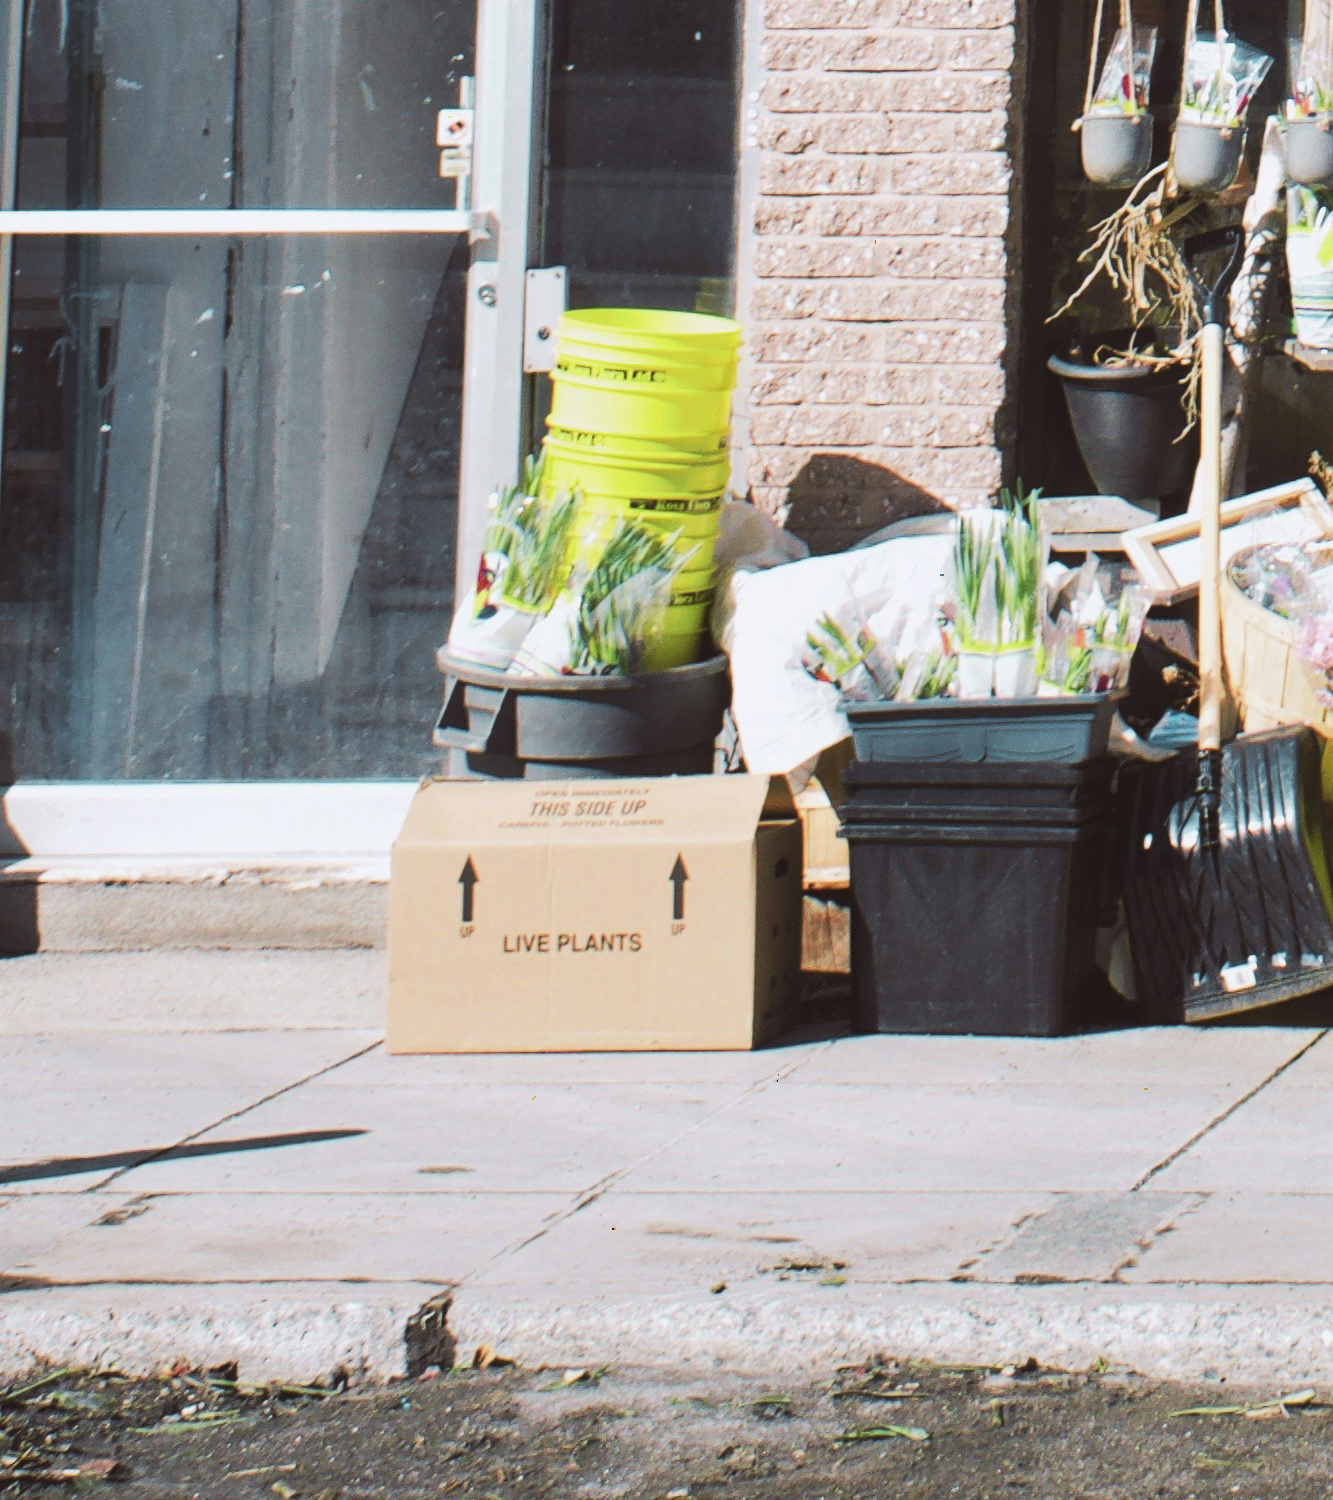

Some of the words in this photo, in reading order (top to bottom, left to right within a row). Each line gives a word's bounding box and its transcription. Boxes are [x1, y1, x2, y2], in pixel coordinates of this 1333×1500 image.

[530, 801, 570, 817] THIS
[575, 800, 617, 816] SIDE
[621, 799, 648, 815] UP
[460, 925, 475, 938] UP
[672, 923, 687, 936] UP
[503, 934, 550, 953] LIVE
[557, 933, 642, 953] PLANTS
